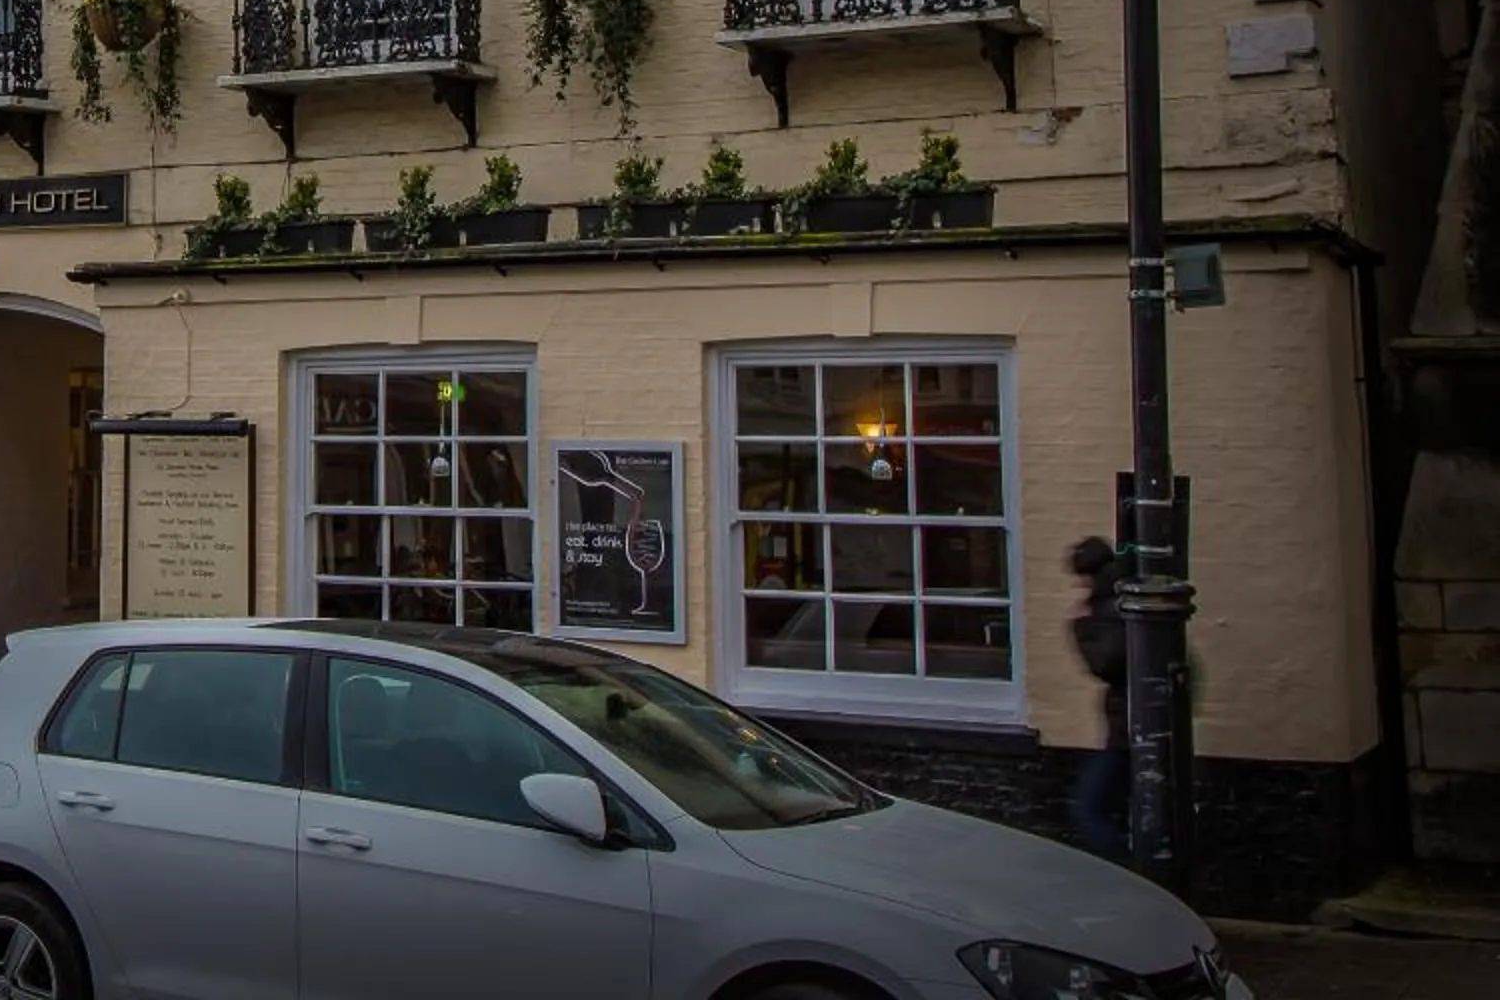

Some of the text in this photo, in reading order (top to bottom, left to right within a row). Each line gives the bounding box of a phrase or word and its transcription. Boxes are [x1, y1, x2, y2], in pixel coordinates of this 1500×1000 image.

[10, 187, 109, 215] HOTEL
[565, 536, 588, 548] eat,
[565, 550, 575, 563] &
